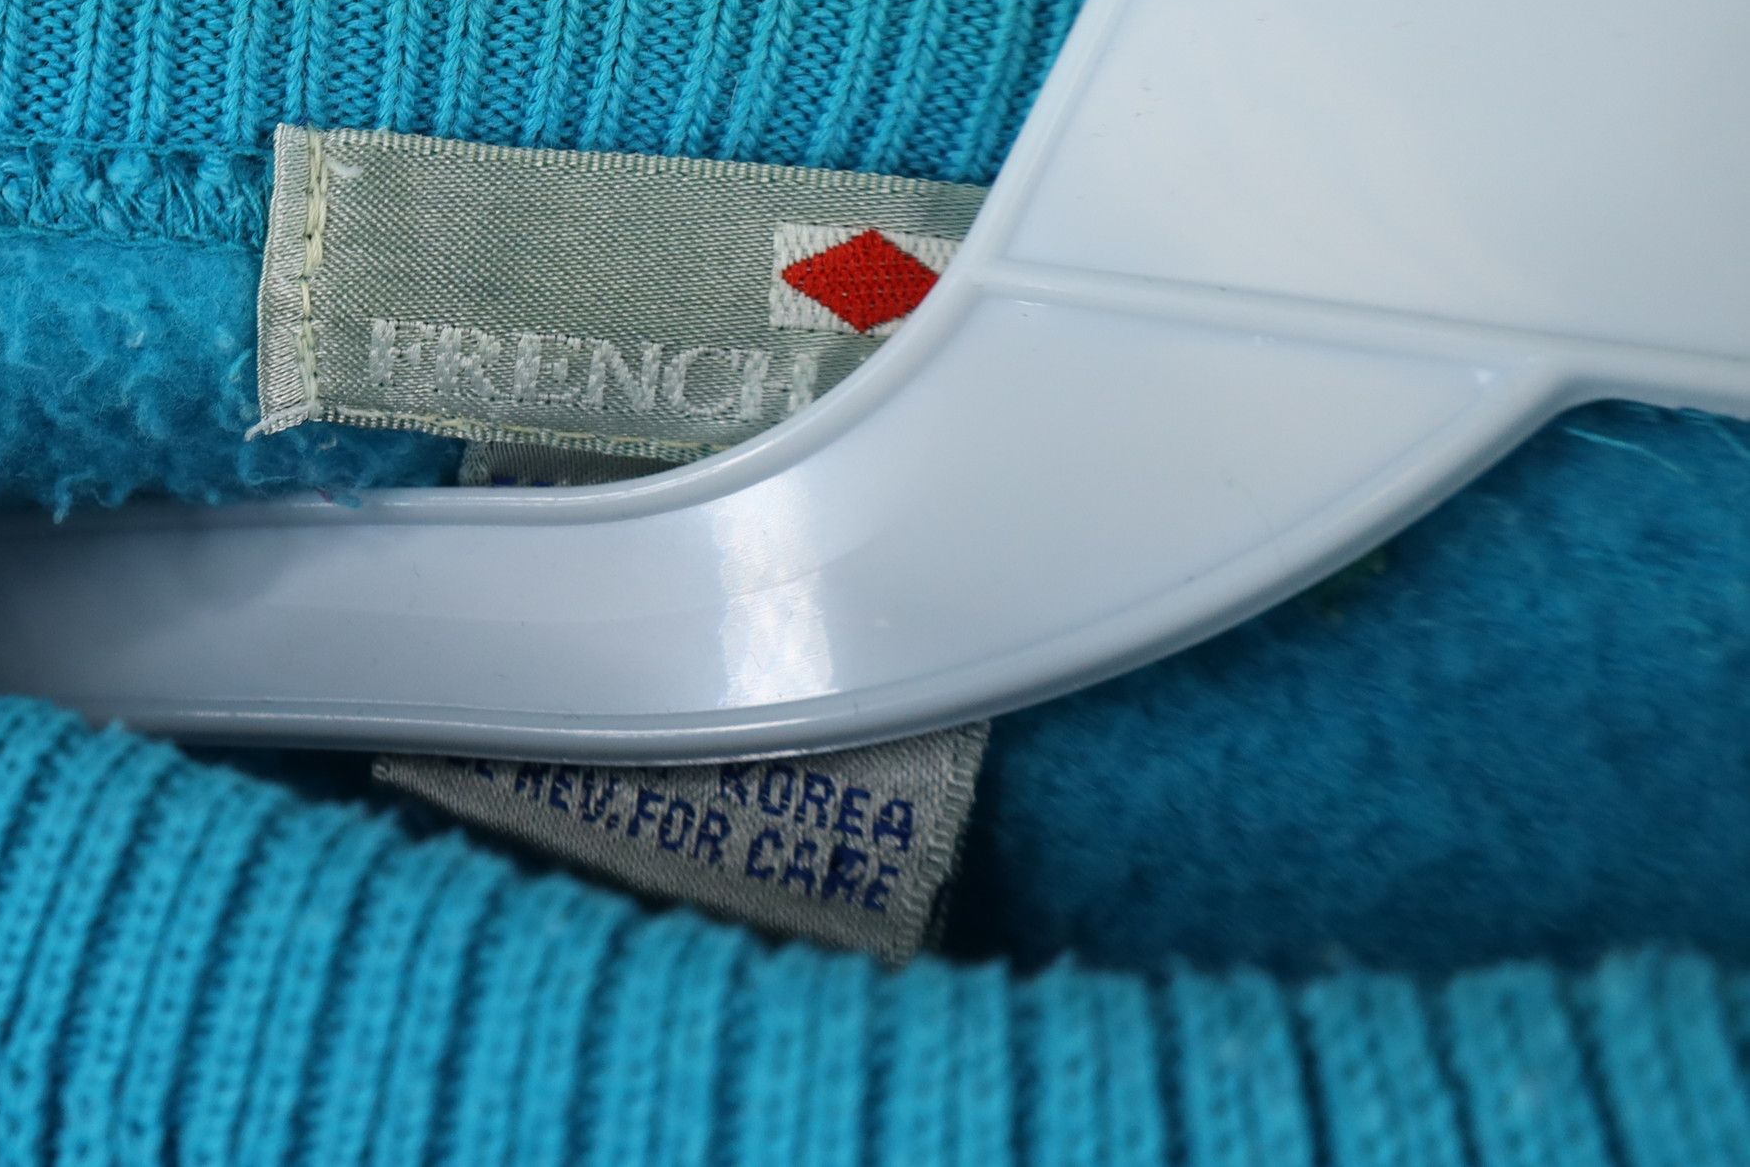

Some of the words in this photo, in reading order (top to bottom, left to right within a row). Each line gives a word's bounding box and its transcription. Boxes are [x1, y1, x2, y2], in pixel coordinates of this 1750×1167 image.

[369, 318, 819, 424] FRENCH
[719, 764, 914, 852] KOREA
[746, 827, 900, 913] CARE
